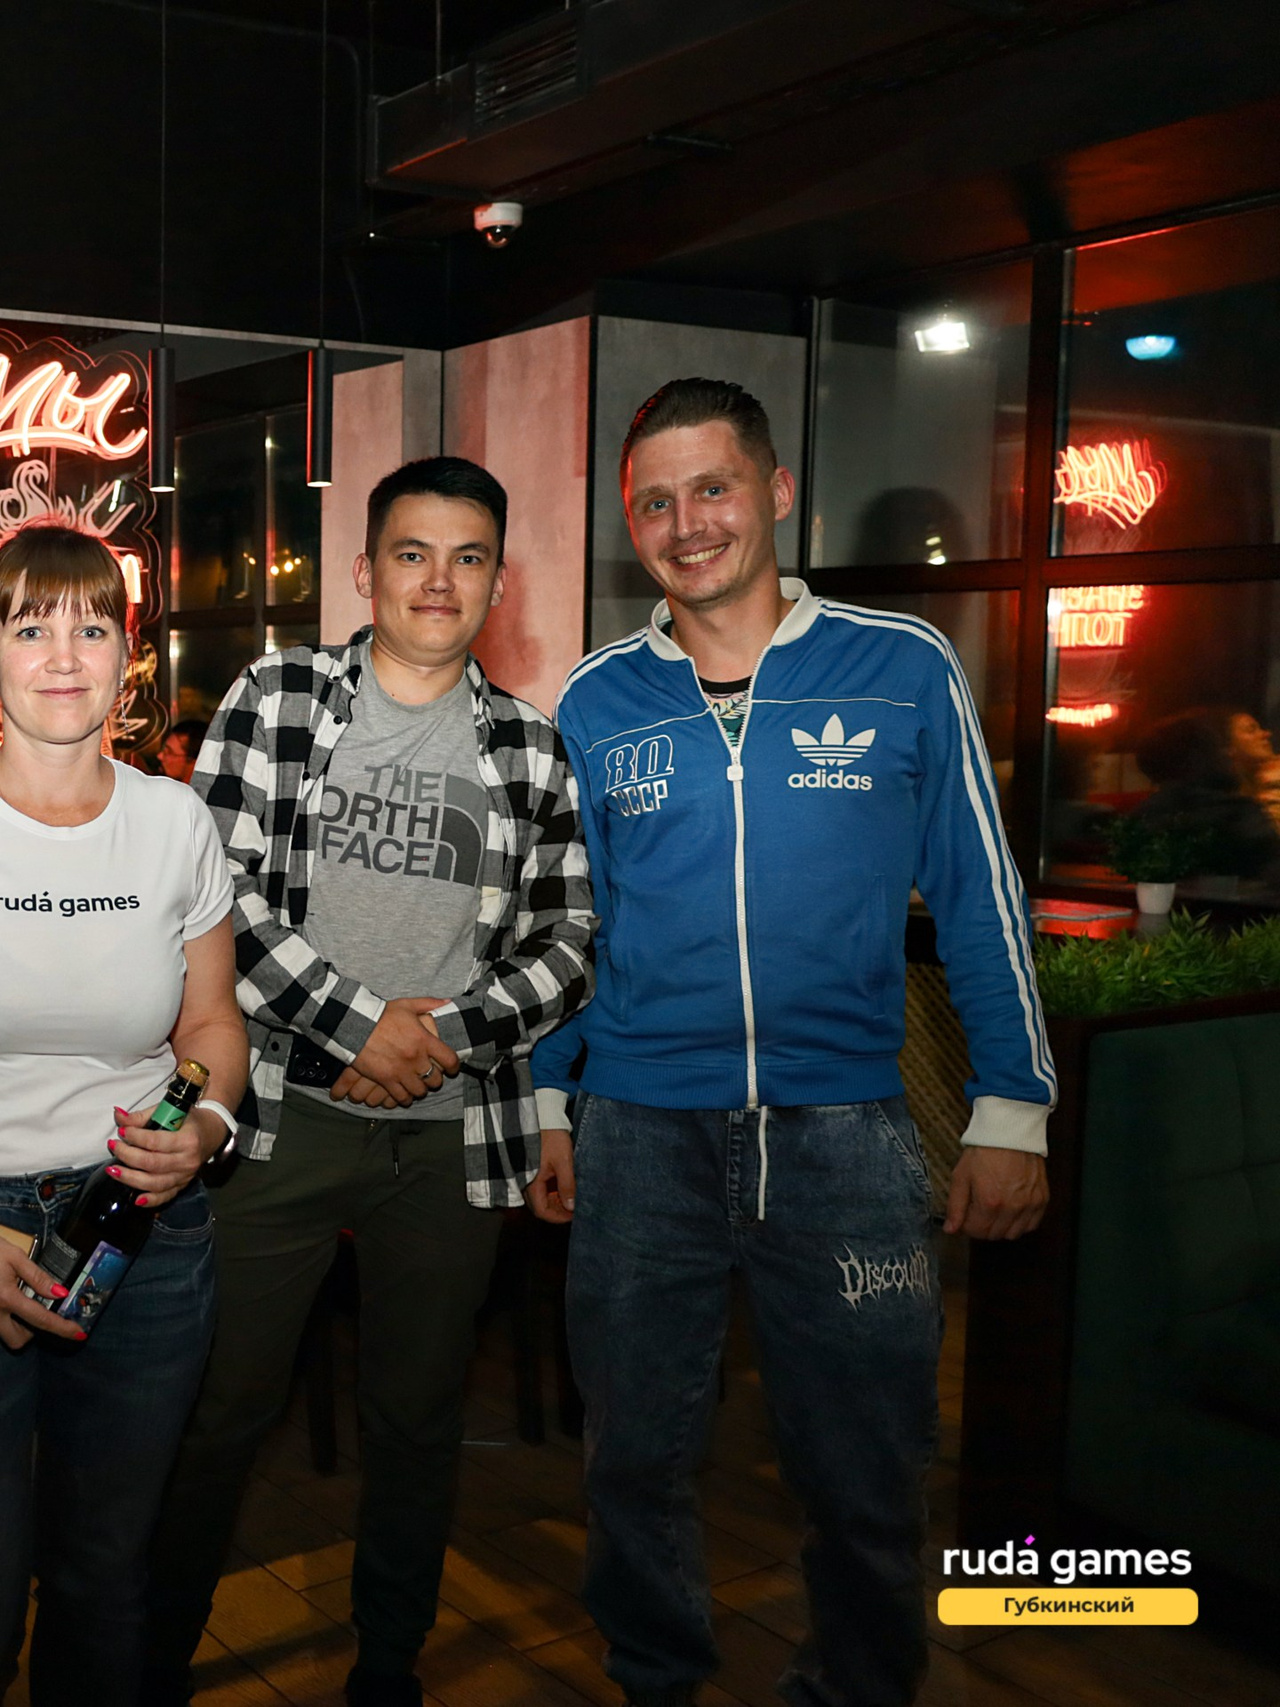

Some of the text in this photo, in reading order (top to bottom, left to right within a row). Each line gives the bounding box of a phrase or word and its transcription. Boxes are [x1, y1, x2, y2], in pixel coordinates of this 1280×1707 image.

[364, 763, 442, 804] THE
[605, 734, 675, 794] 80
[787, 768, 873, 791] adidas
[320, 784, 439, 840] ORTH
[321, 823, 431, 878] FACE
[59, 895, 141, 918] games
